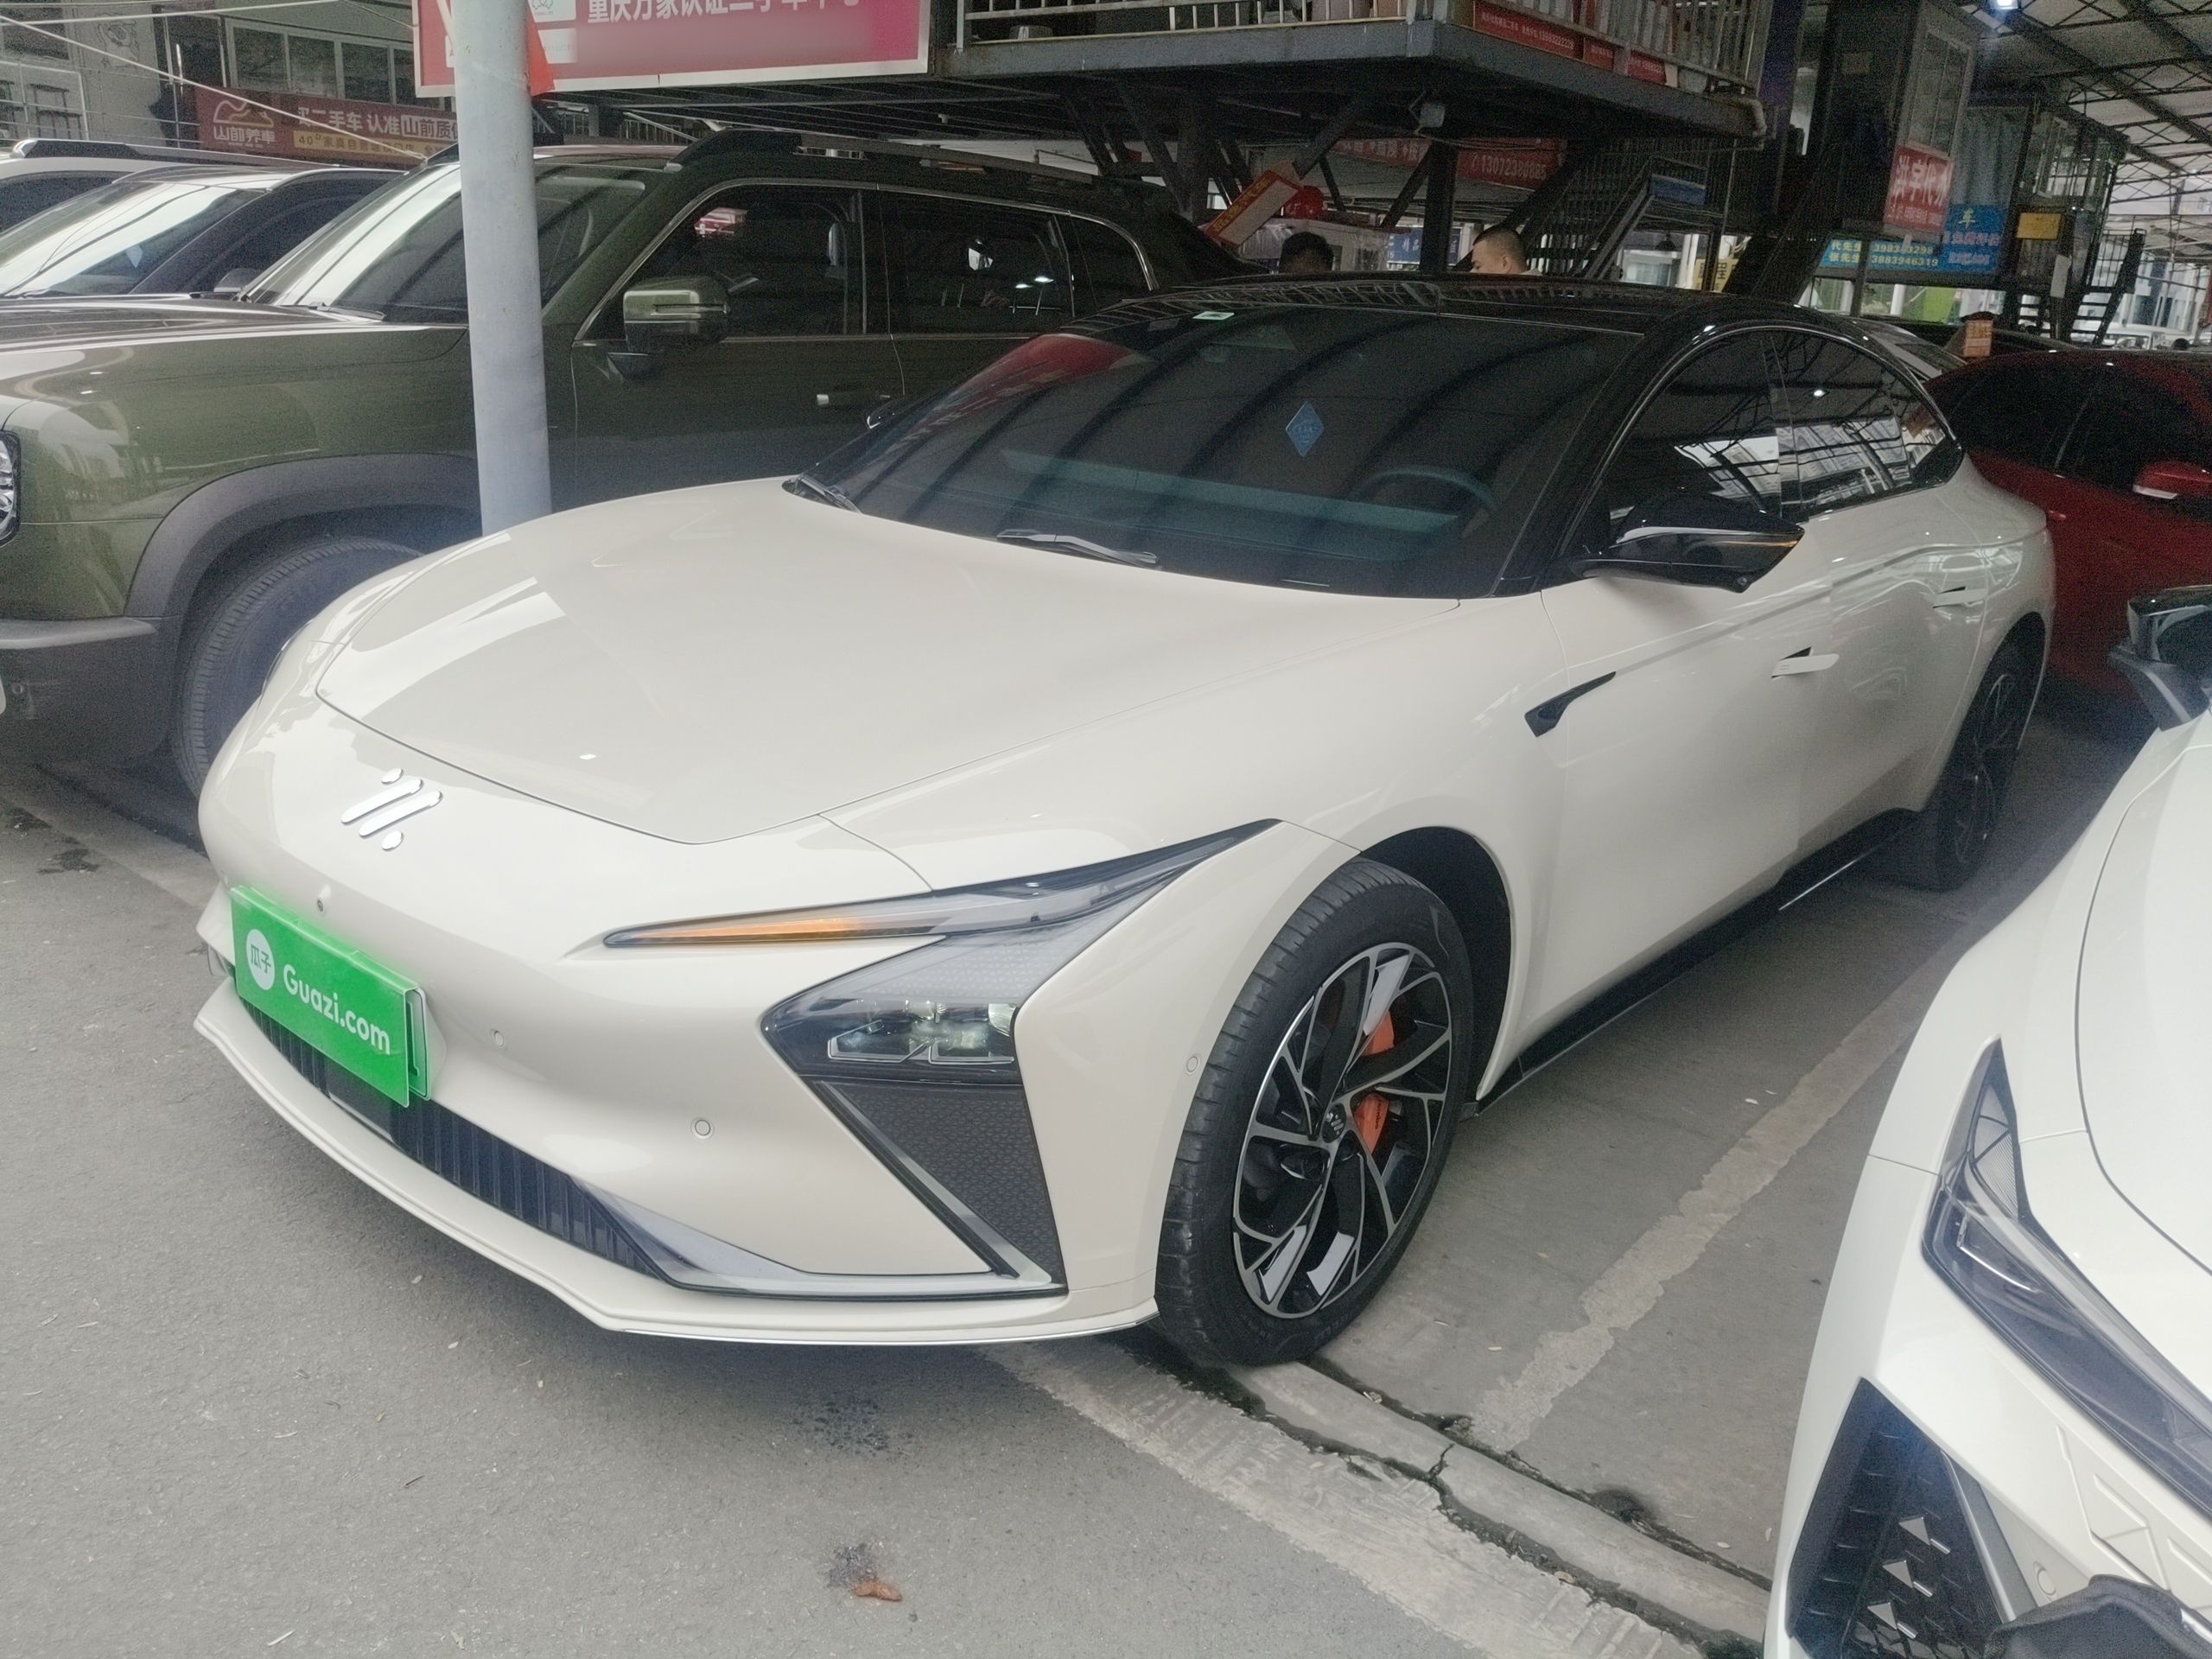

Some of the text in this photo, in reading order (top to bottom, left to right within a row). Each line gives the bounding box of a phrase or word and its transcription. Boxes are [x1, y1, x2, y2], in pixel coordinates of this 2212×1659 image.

[588, 0, 859, 23] 重庆万家认证
[251, 944, 272, 975] 瓜子
[283, 963, 391, 1055] Guazi.com
